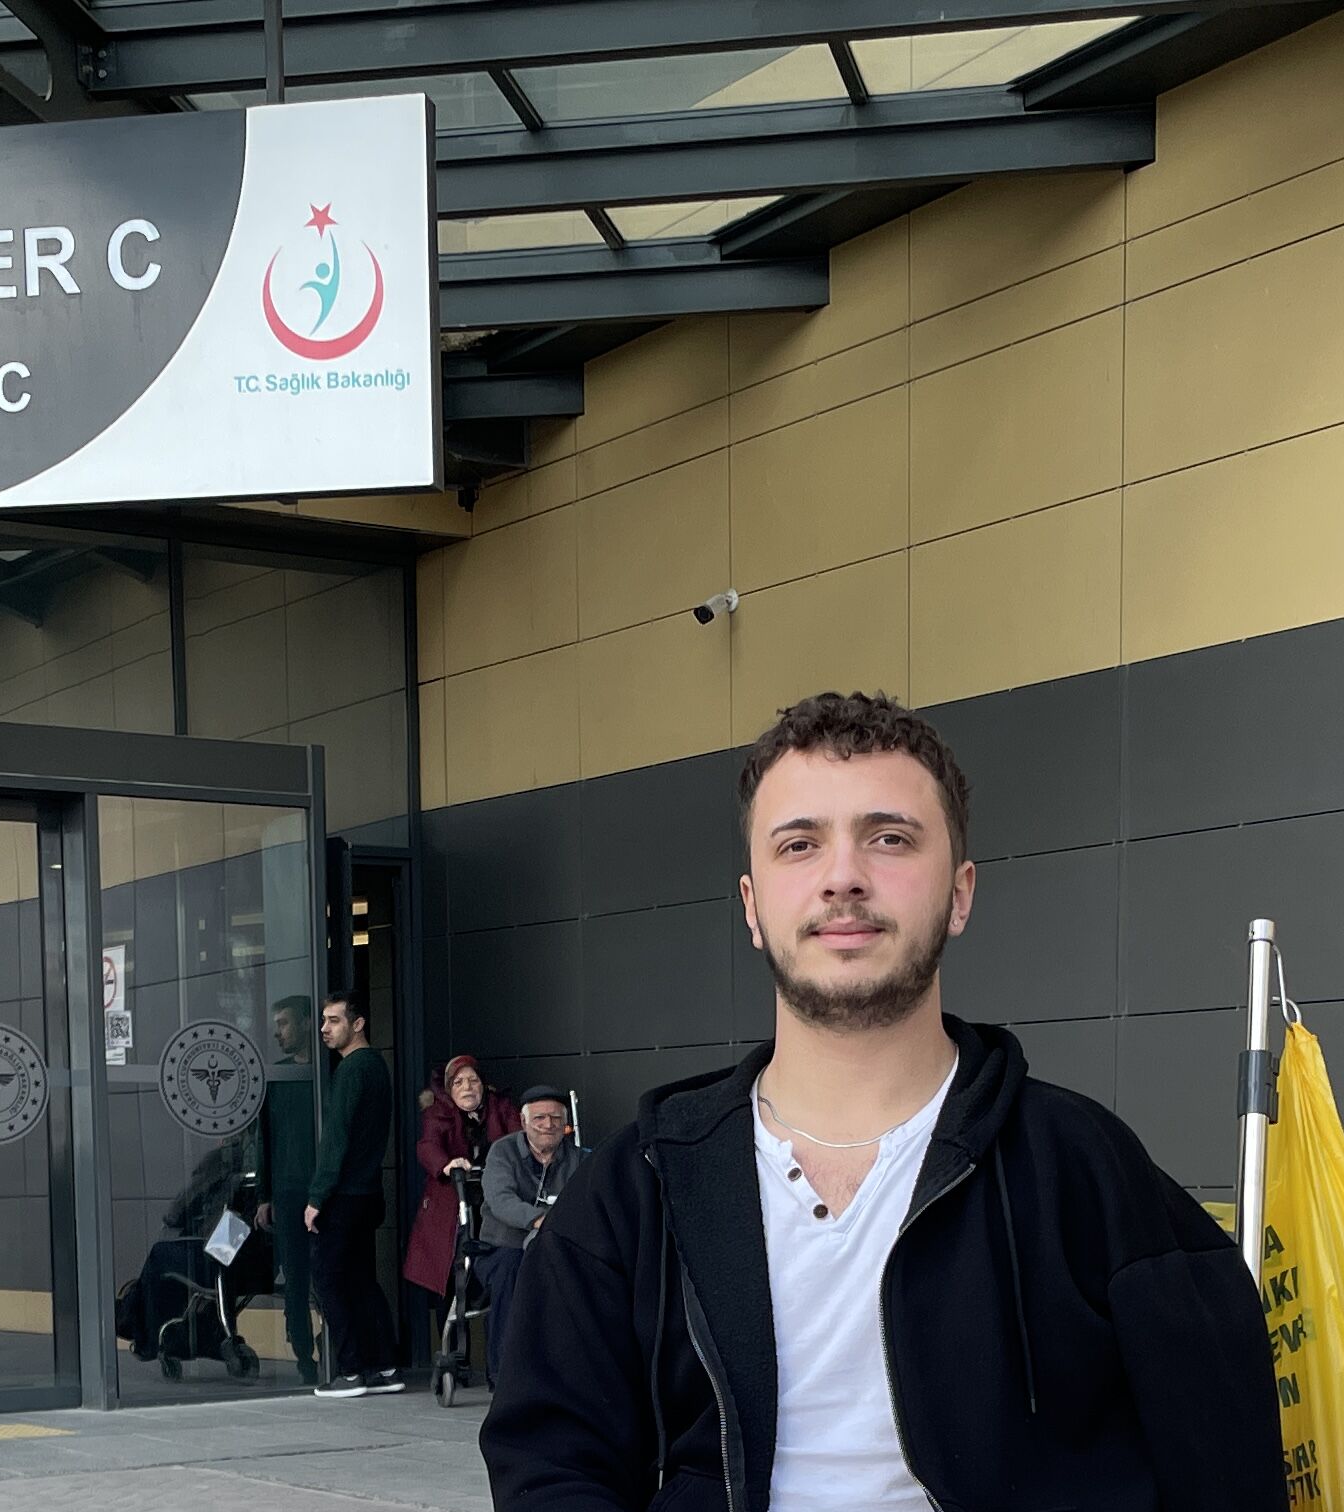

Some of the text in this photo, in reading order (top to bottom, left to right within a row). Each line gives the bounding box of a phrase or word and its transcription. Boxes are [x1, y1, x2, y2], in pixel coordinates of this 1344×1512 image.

[106, 217, 162, 292] C
[265, 373, 321, 396] Sağlık
[327, 369, 410, 391] Bakanlığı
